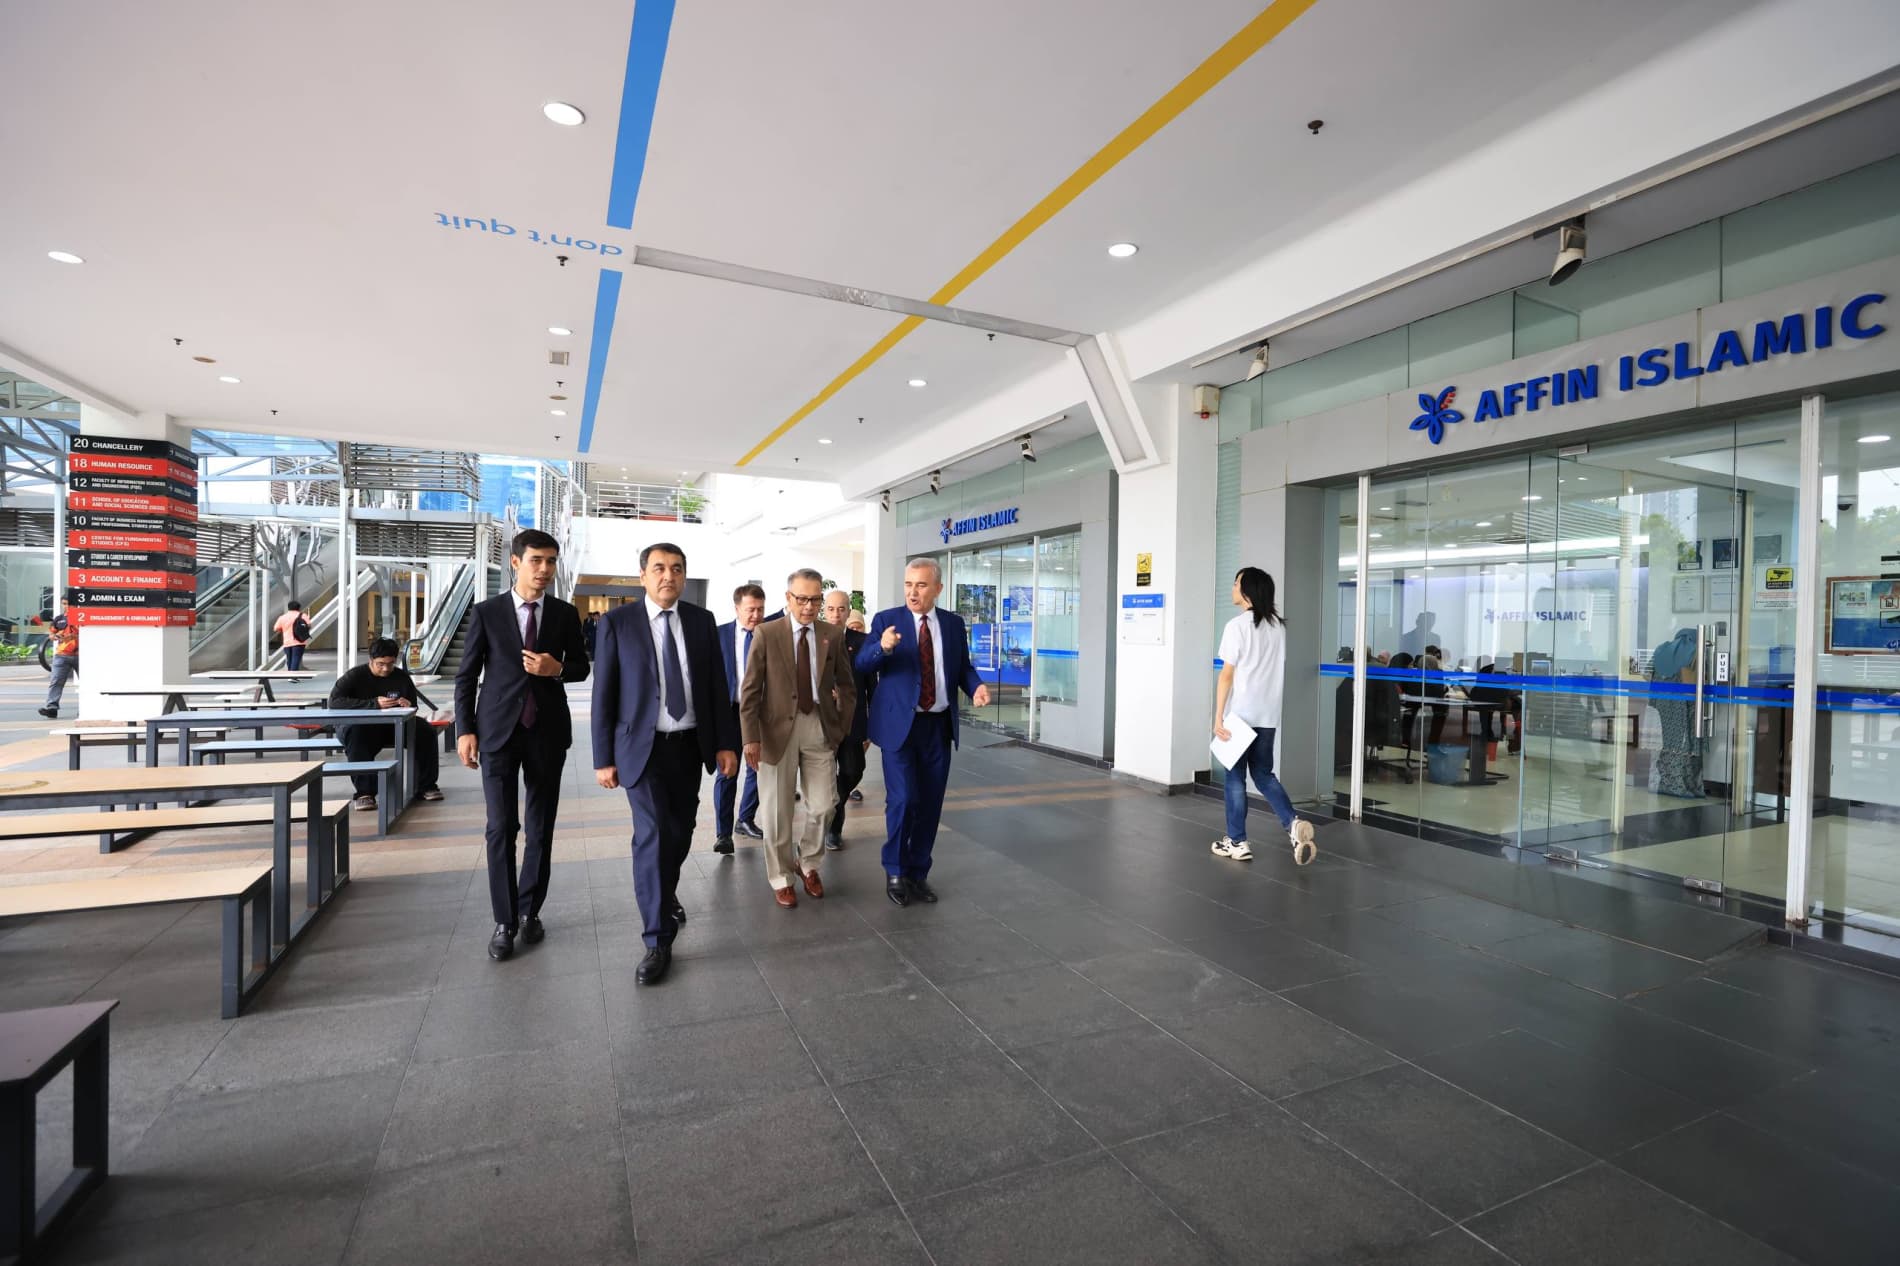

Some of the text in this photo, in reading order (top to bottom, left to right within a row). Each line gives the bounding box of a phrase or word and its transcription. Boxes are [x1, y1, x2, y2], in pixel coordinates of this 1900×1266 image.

[434, 212, 622, 256] don't quit
[1473, 293, 1887, 423] AFFIN ISLAMIC
[73, 437, 143, 452] 20 CHANCELLERY
[73, 458, 88, 468] 18
[73, 478, 87, 487] 12
[74, 497, 86, 506] 11
[72, 516, 87, 526] 10
[953, 507, 1018, 536] AFFIN ISLAMIC
[79, 535, 87, 545] 9
[78, 555, 86, 564] 4
[78, 573, 86, 583] 3
[91, 575, 124, 583] ACCOUNT
[133, 576, 162, 584] FINANCE
[78, 593, 86, 603] 3
[78, 612, 86, 622] 2
